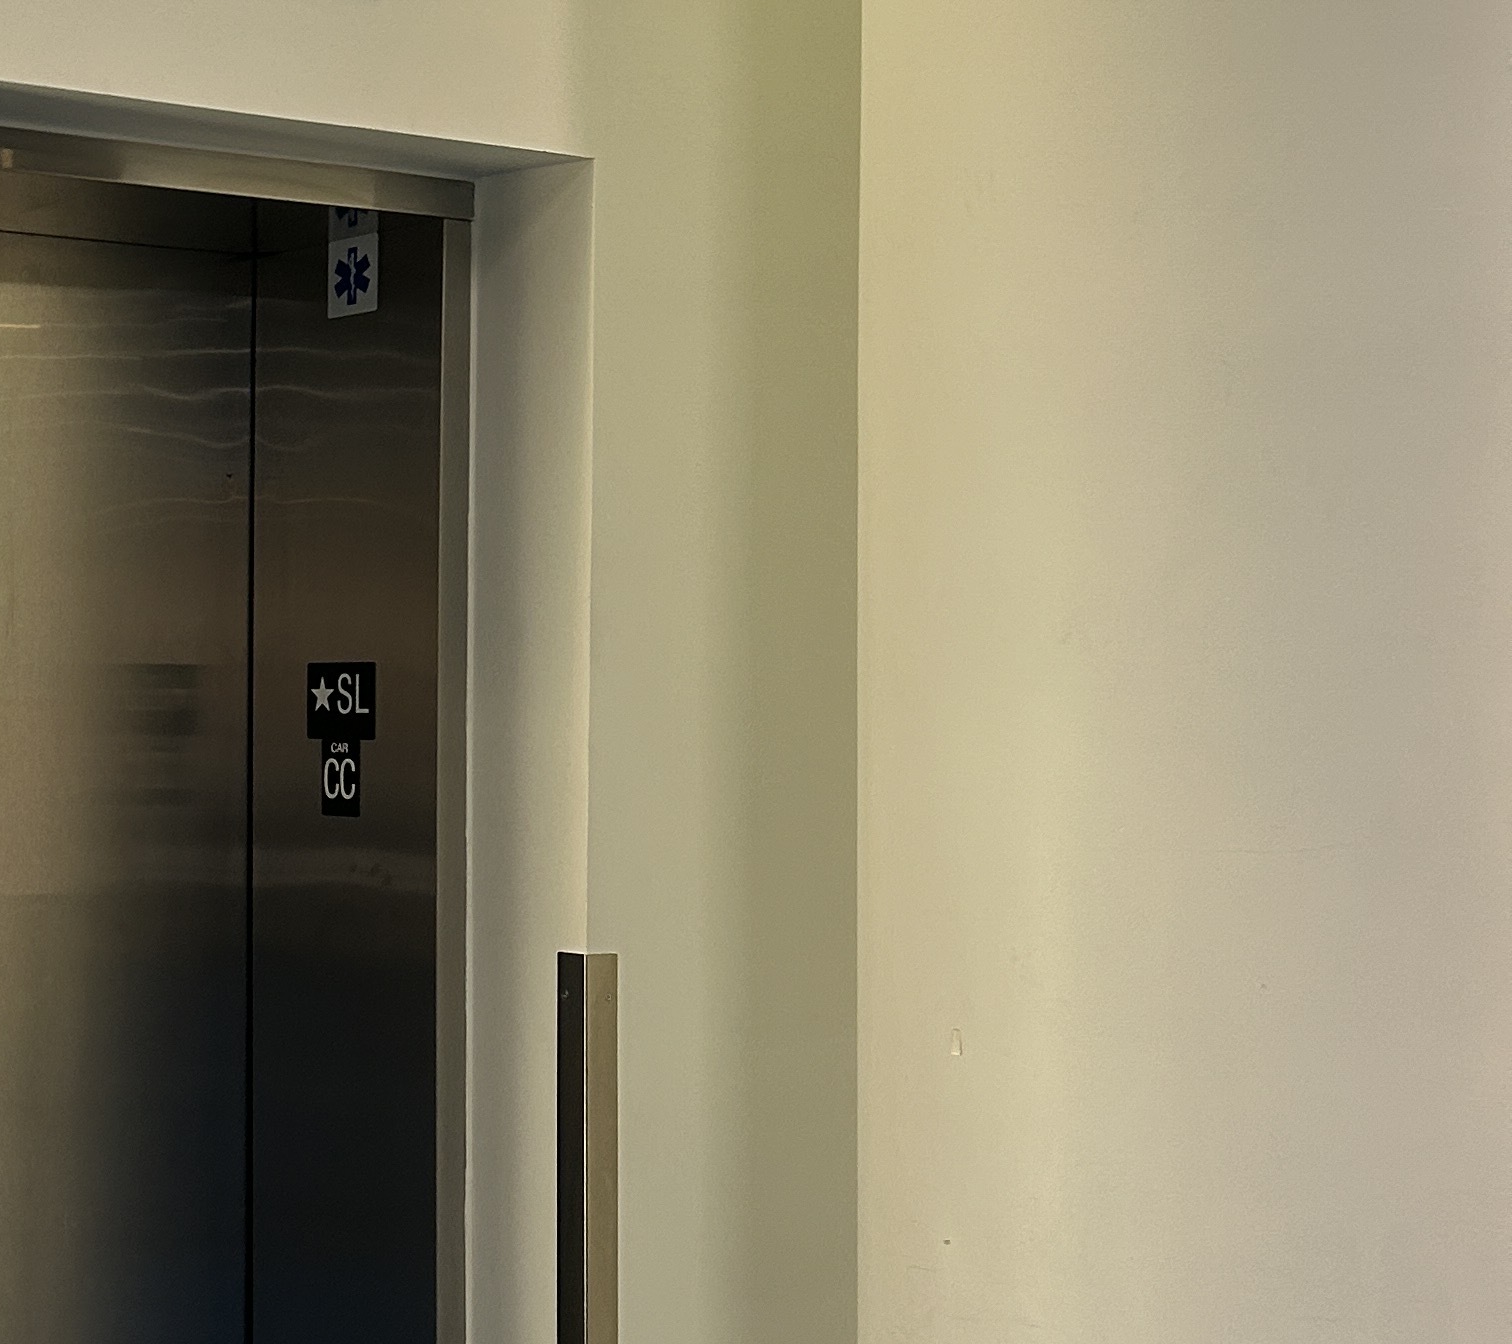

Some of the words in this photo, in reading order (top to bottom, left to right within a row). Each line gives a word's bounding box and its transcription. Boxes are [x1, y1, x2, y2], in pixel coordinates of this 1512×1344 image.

[336, 672, 370, 715] SL
[330, 742, 349, 754] CAR
[323, 757, 356, 800] CC
